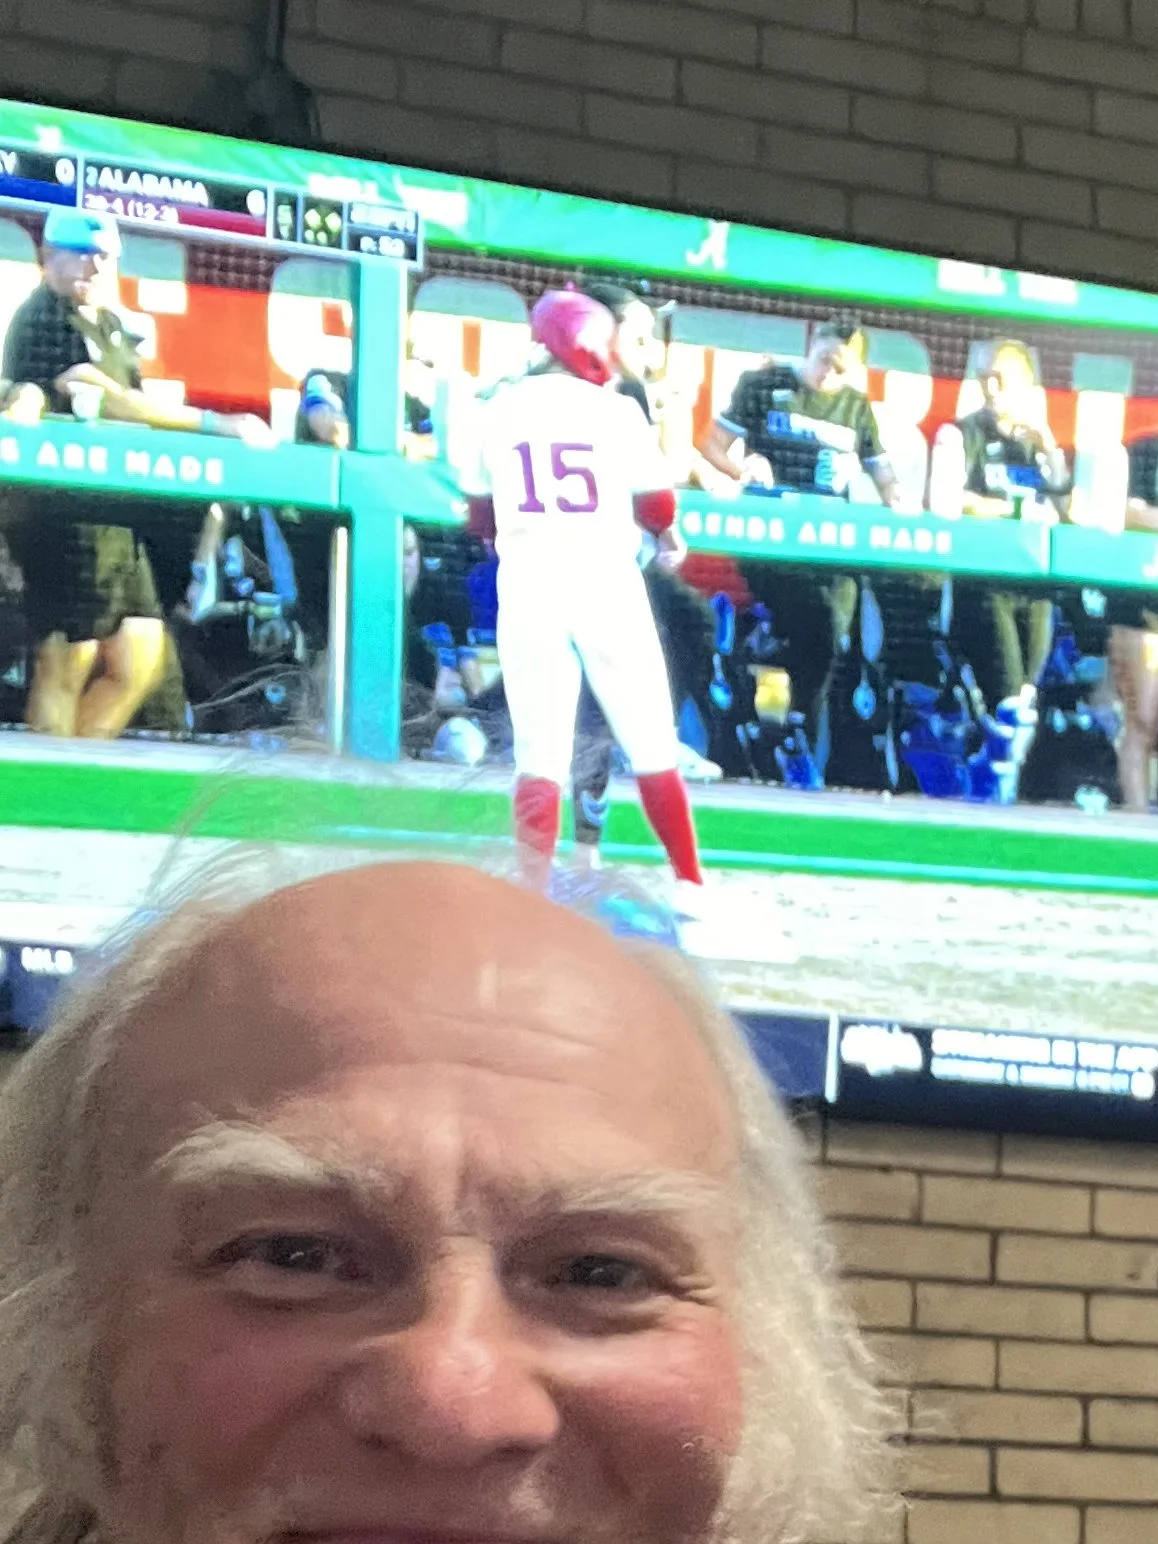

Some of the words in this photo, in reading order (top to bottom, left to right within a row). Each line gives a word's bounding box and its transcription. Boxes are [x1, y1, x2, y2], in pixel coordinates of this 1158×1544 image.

[98, 166, 210, 208] ALABAMA
[124, 450, 224, 485] MADE
[512, 441, 599, 513] 15
[869, 526, 951, 554] MADE
